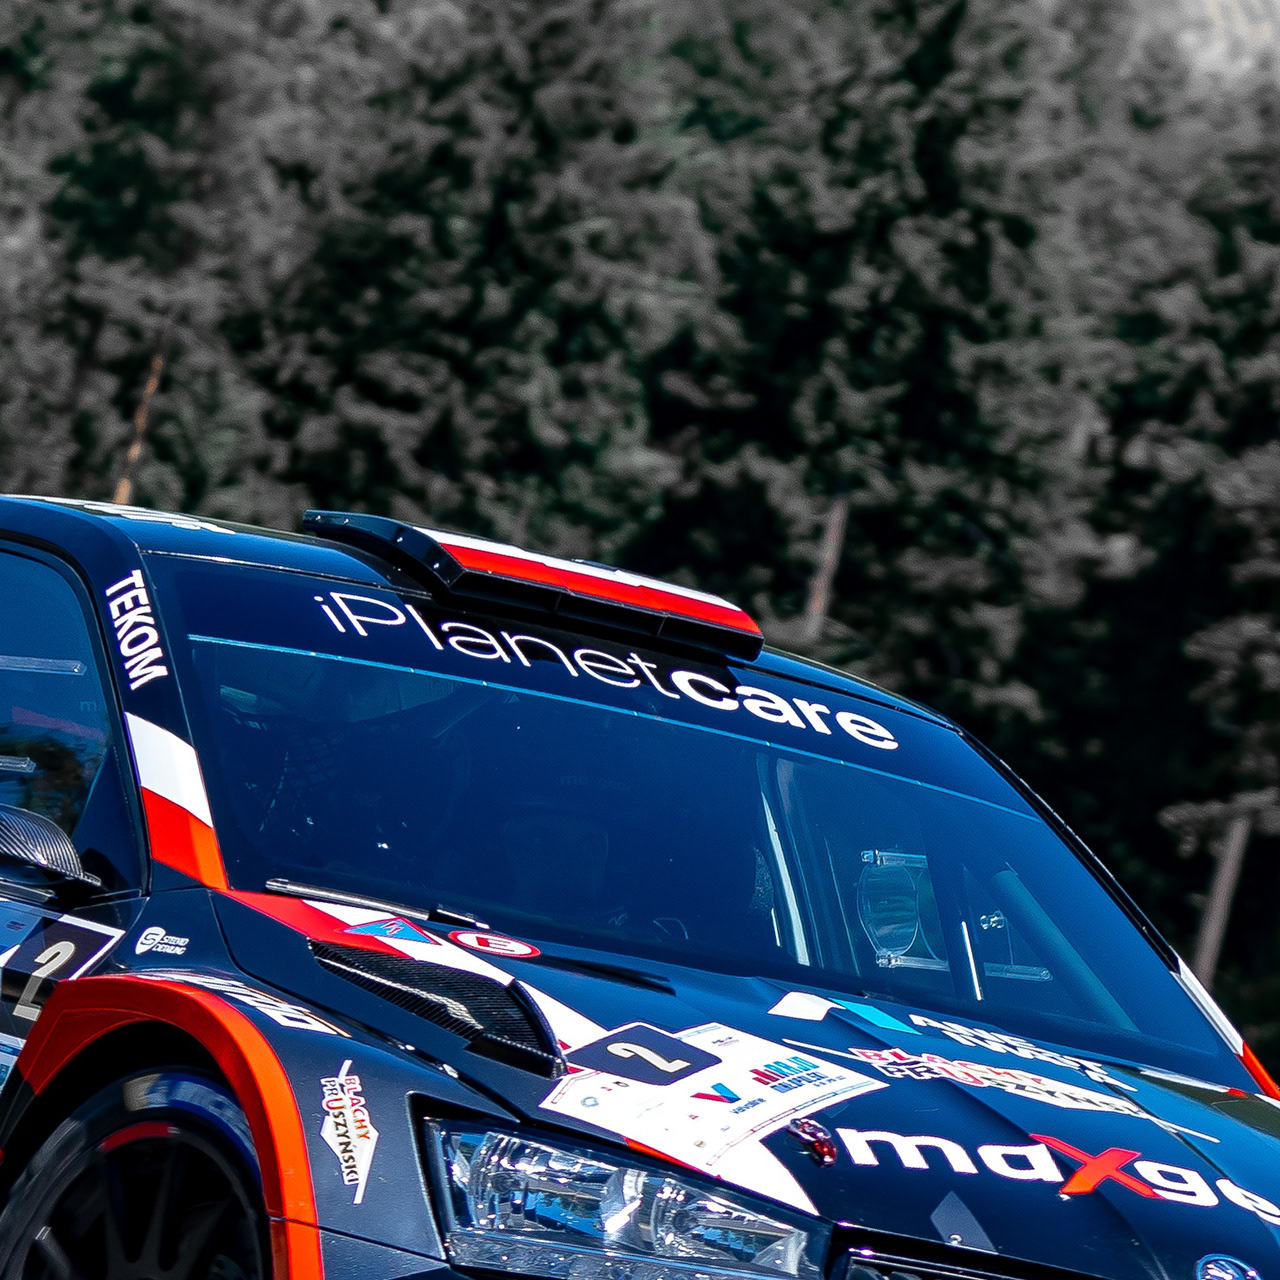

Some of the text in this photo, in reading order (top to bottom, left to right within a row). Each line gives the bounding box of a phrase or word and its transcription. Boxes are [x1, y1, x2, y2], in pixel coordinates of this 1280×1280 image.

[105, 568, 169, 691] TEKOM
[314, 591, 899, 751] iPlanetcare
[12, 940, 76, 1022] 2
[606, 1041, 692, 1074] 2
[343, 1075, 372, 1142] BLACHY
